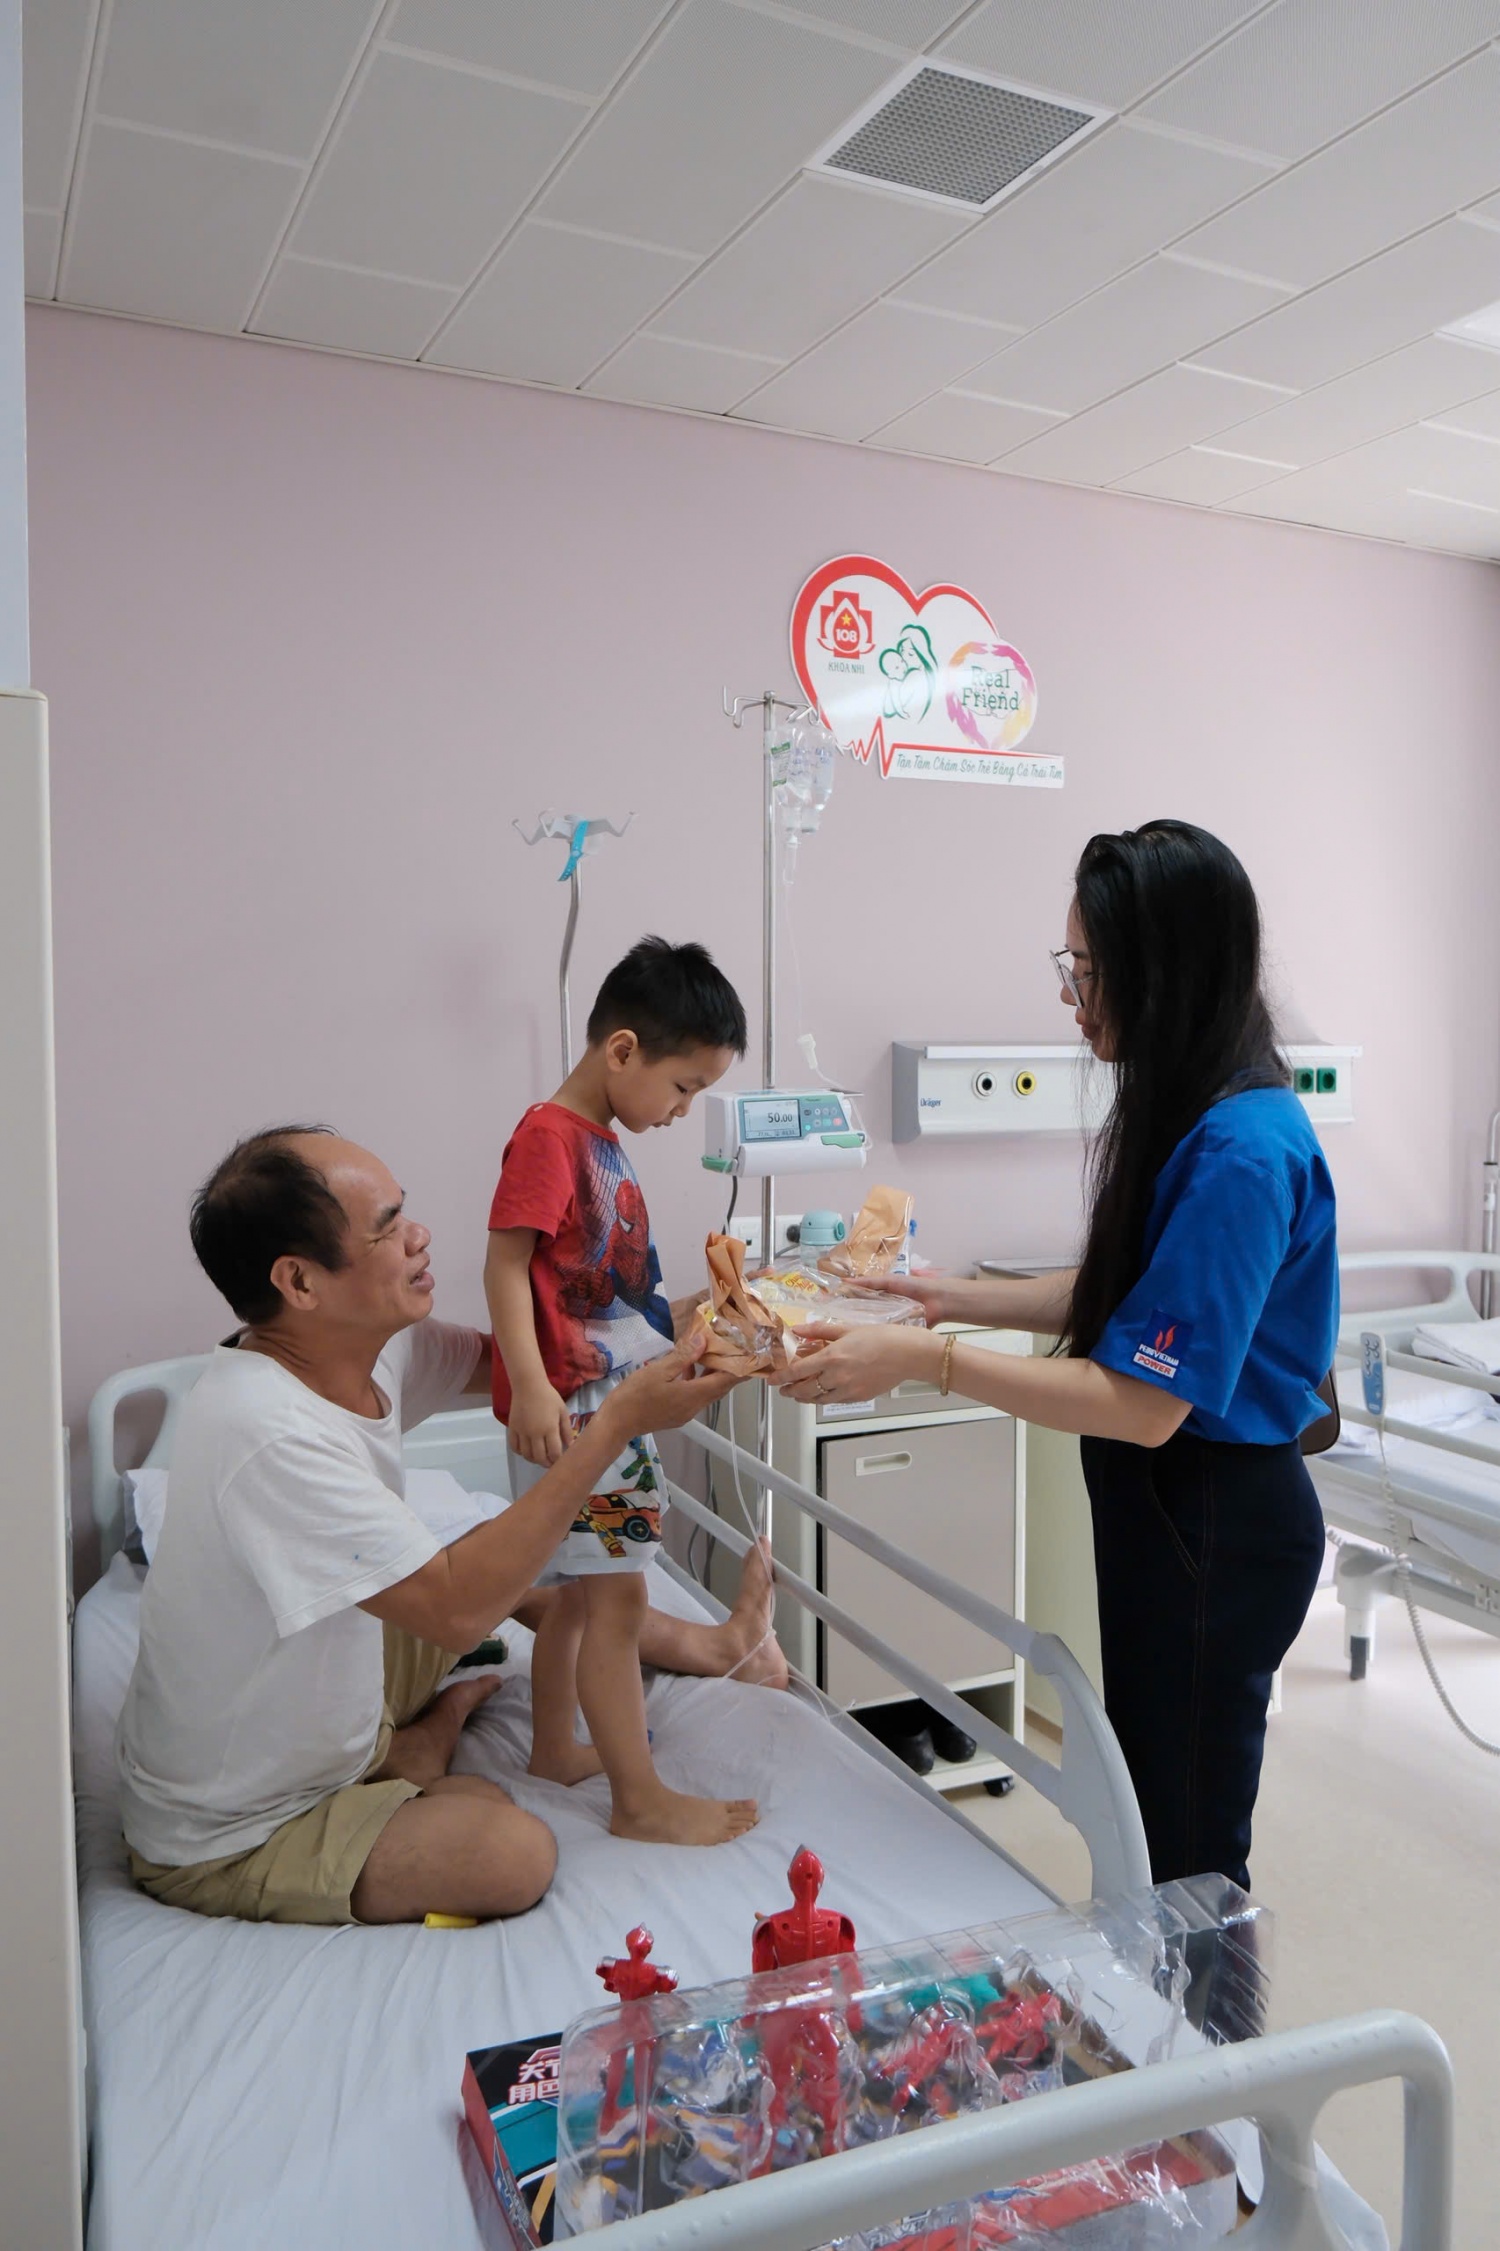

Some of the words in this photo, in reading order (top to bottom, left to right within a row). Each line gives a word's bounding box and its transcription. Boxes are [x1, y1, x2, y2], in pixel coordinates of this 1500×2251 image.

[835, 629, 858, 644] 108
[828, 661, 850, 673] KHOA
[851, 663, 865, 675] NHI
[971, 665, 1010, 689] Real
[961, 687, 1020, 711] Friend
[1049, 764, 1063, 780] Tim
[767, 1112, 793, 1124] 50.00
[1136, 1354, 1173, 1376] POWER
